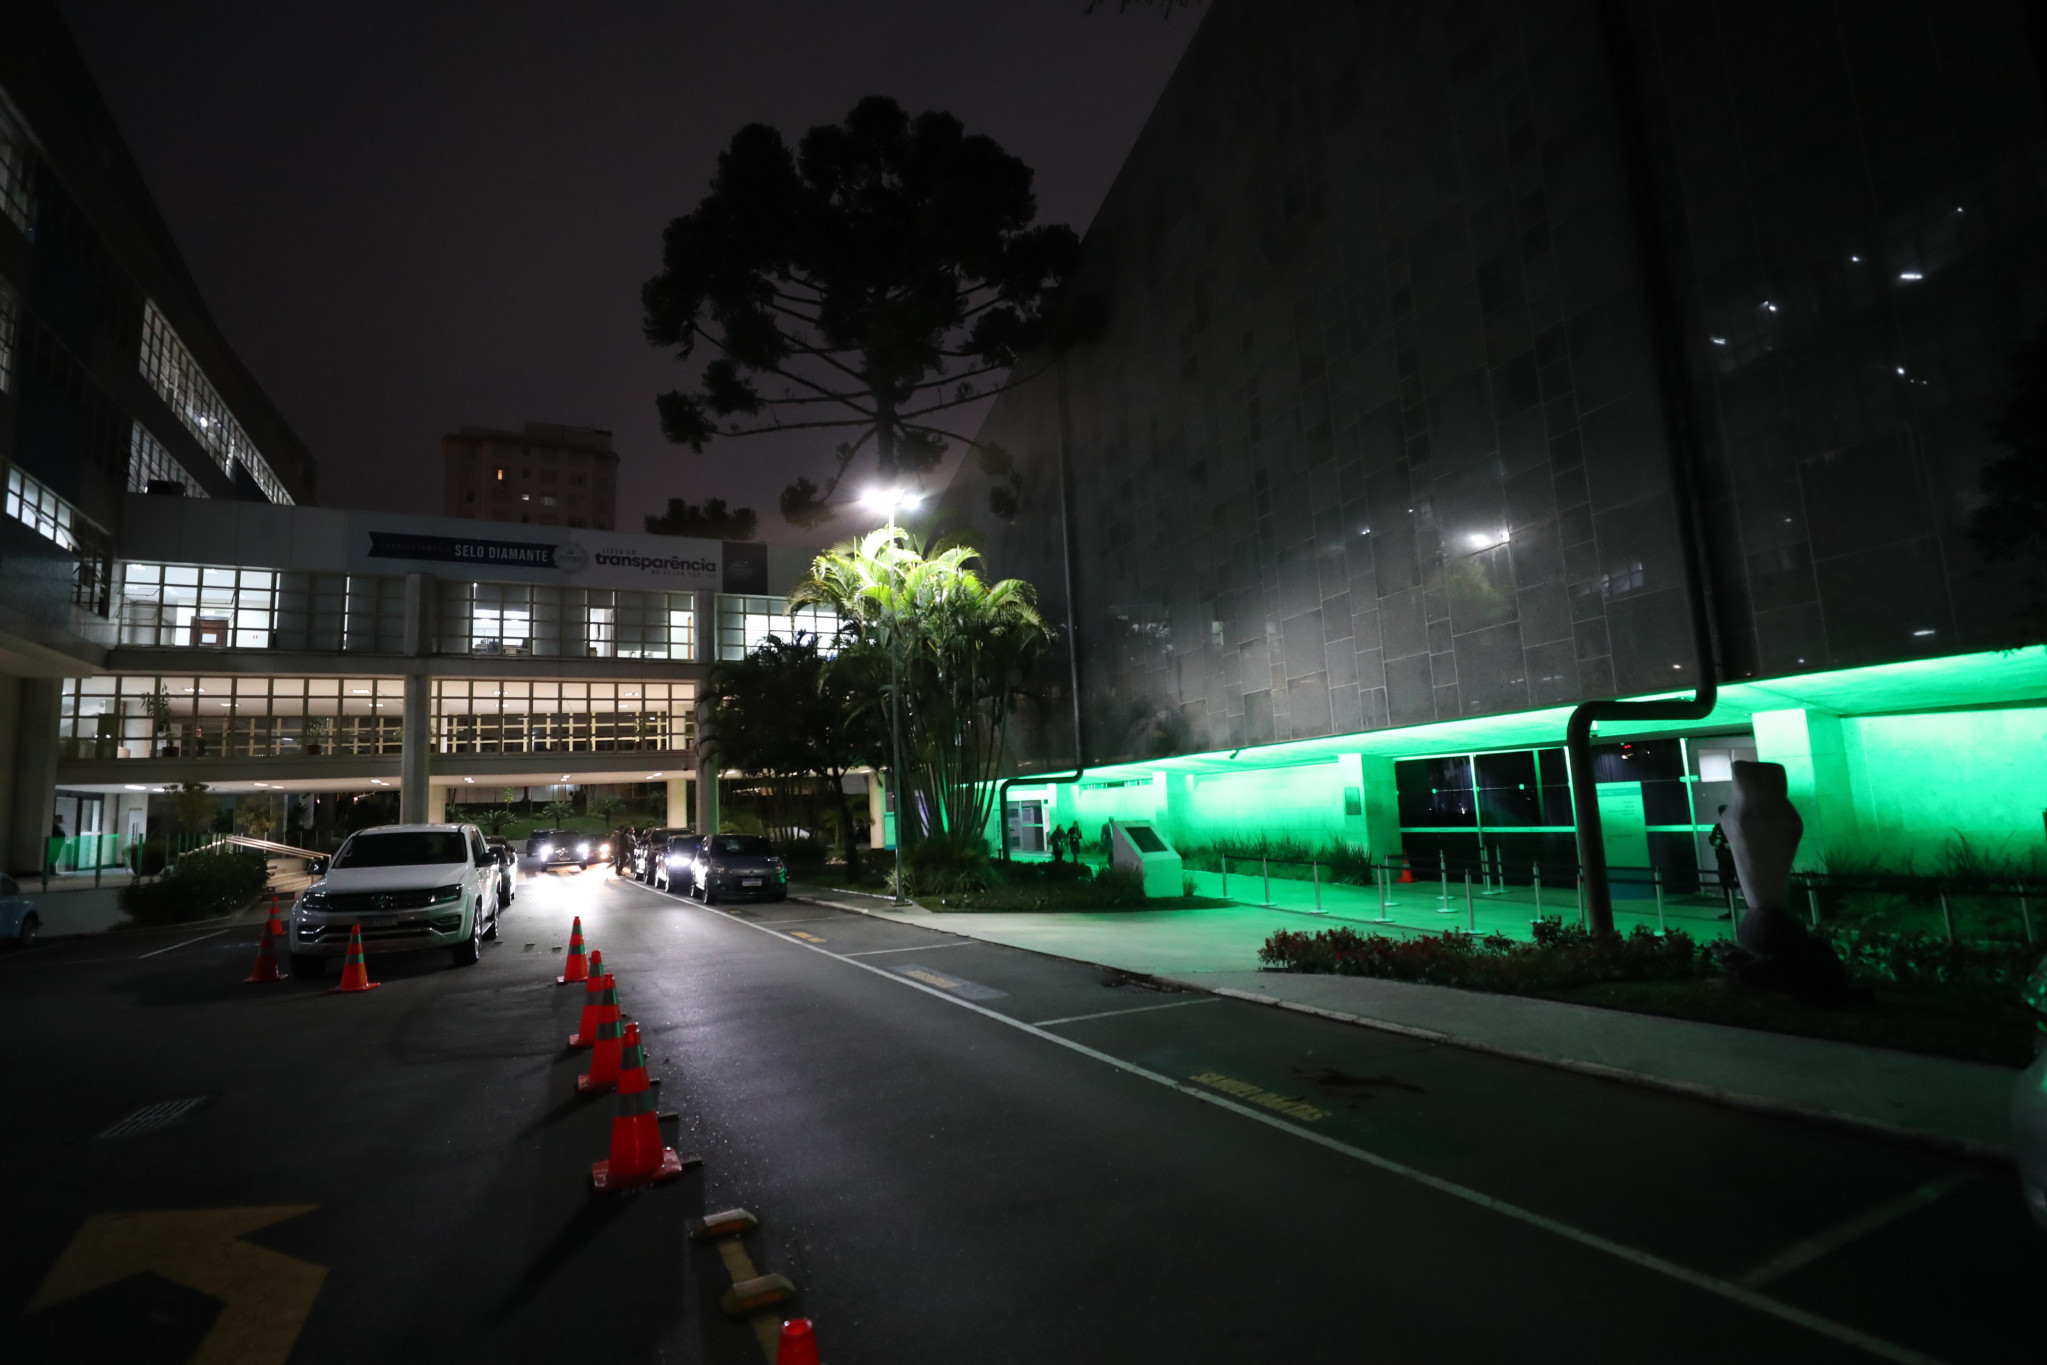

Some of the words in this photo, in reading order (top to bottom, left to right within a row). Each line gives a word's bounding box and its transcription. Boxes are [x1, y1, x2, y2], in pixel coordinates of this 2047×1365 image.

[454, 544, 485, 559] SELO
[488, 546, 549, 563] DIAMANTE
[594, 552, 716, 572] transparência
